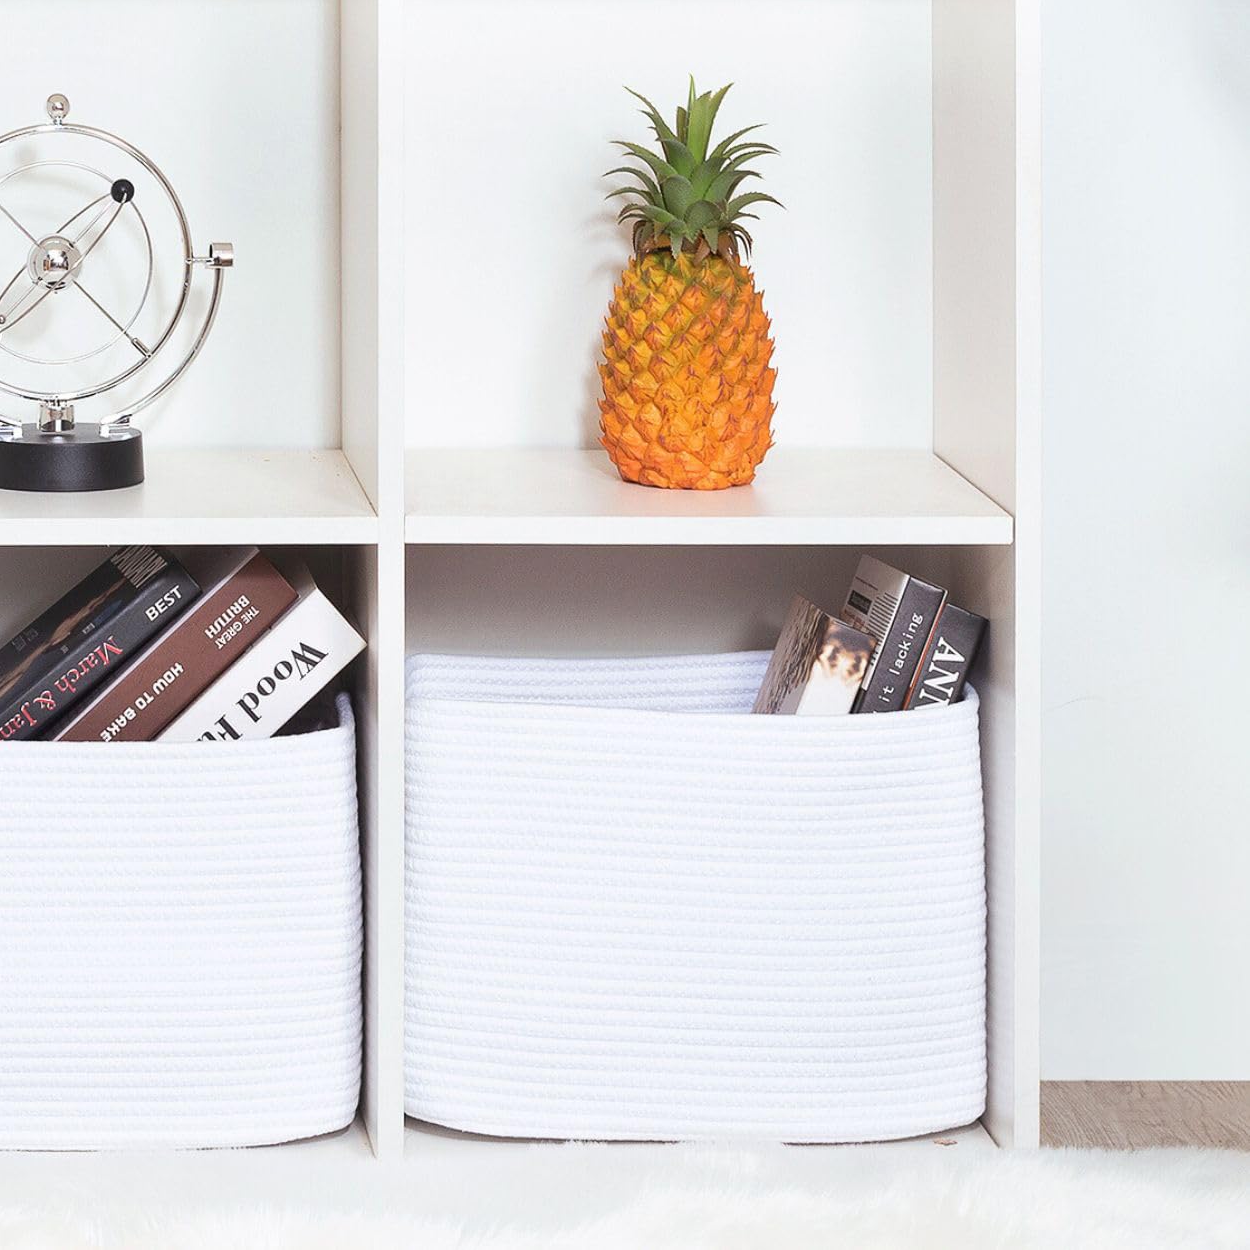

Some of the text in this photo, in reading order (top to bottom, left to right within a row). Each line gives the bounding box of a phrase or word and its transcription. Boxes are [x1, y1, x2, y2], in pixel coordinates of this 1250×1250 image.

[145, 585, 182, 622] BEST
[204, 594, 251, 639] BRITISH
[216, 606, 260, 650] THE GREAT
[54, 634, 124, 689] March
[235, 641, 329, 722] Wood
[879, 612, 924, 703] it lacking
[32, 688, 57, 714] &
[100, 662, 184, 741] HOW TO BAKE
